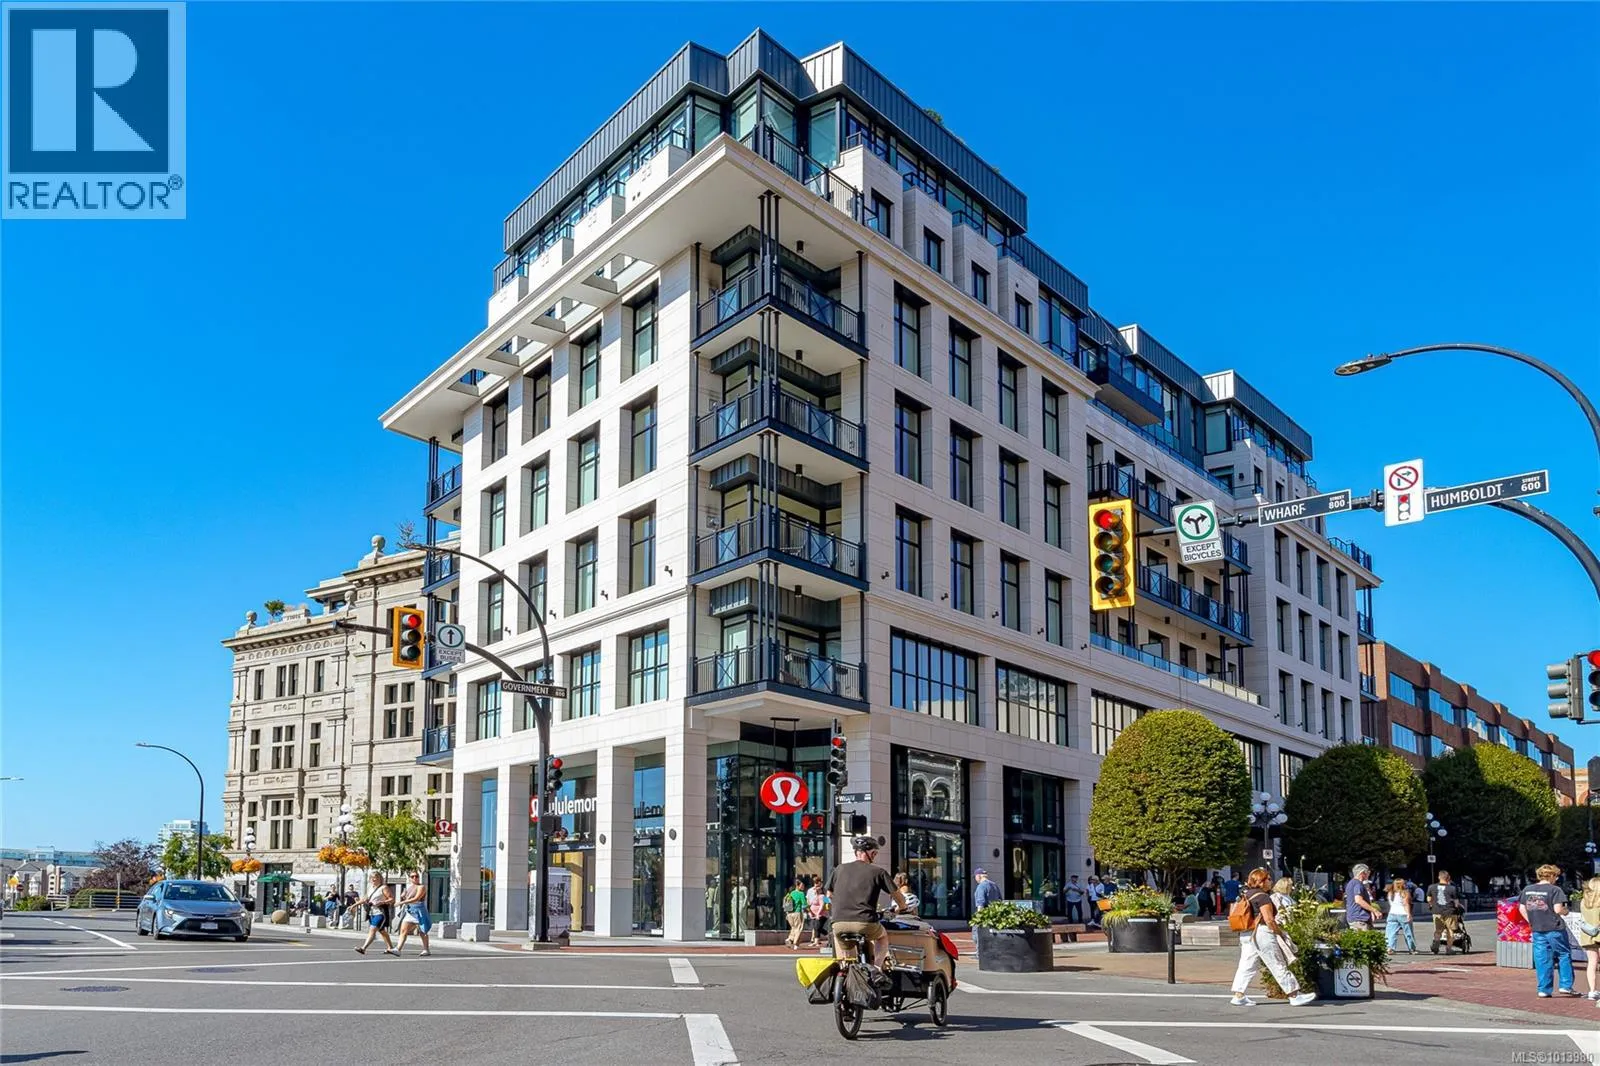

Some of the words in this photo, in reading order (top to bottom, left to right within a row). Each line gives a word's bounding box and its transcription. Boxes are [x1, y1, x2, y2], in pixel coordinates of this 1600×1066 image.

[1431, 483, 1503, 508] HUMBOLDT
[1521, 481, 1541, 492] 600
[1264, 503, 1306, 521] WHARF
[1328, 499, 1345, 509] 800
[1185, 542, 1216, 553] EXCEPT
[1184, 549, 1222, 561] BICYCLES
[438, 649, 462, 657] EXCEPT
[502, 682, 549, 694] GOVERNMENT
[548, 795, 598, 815] ululemon
